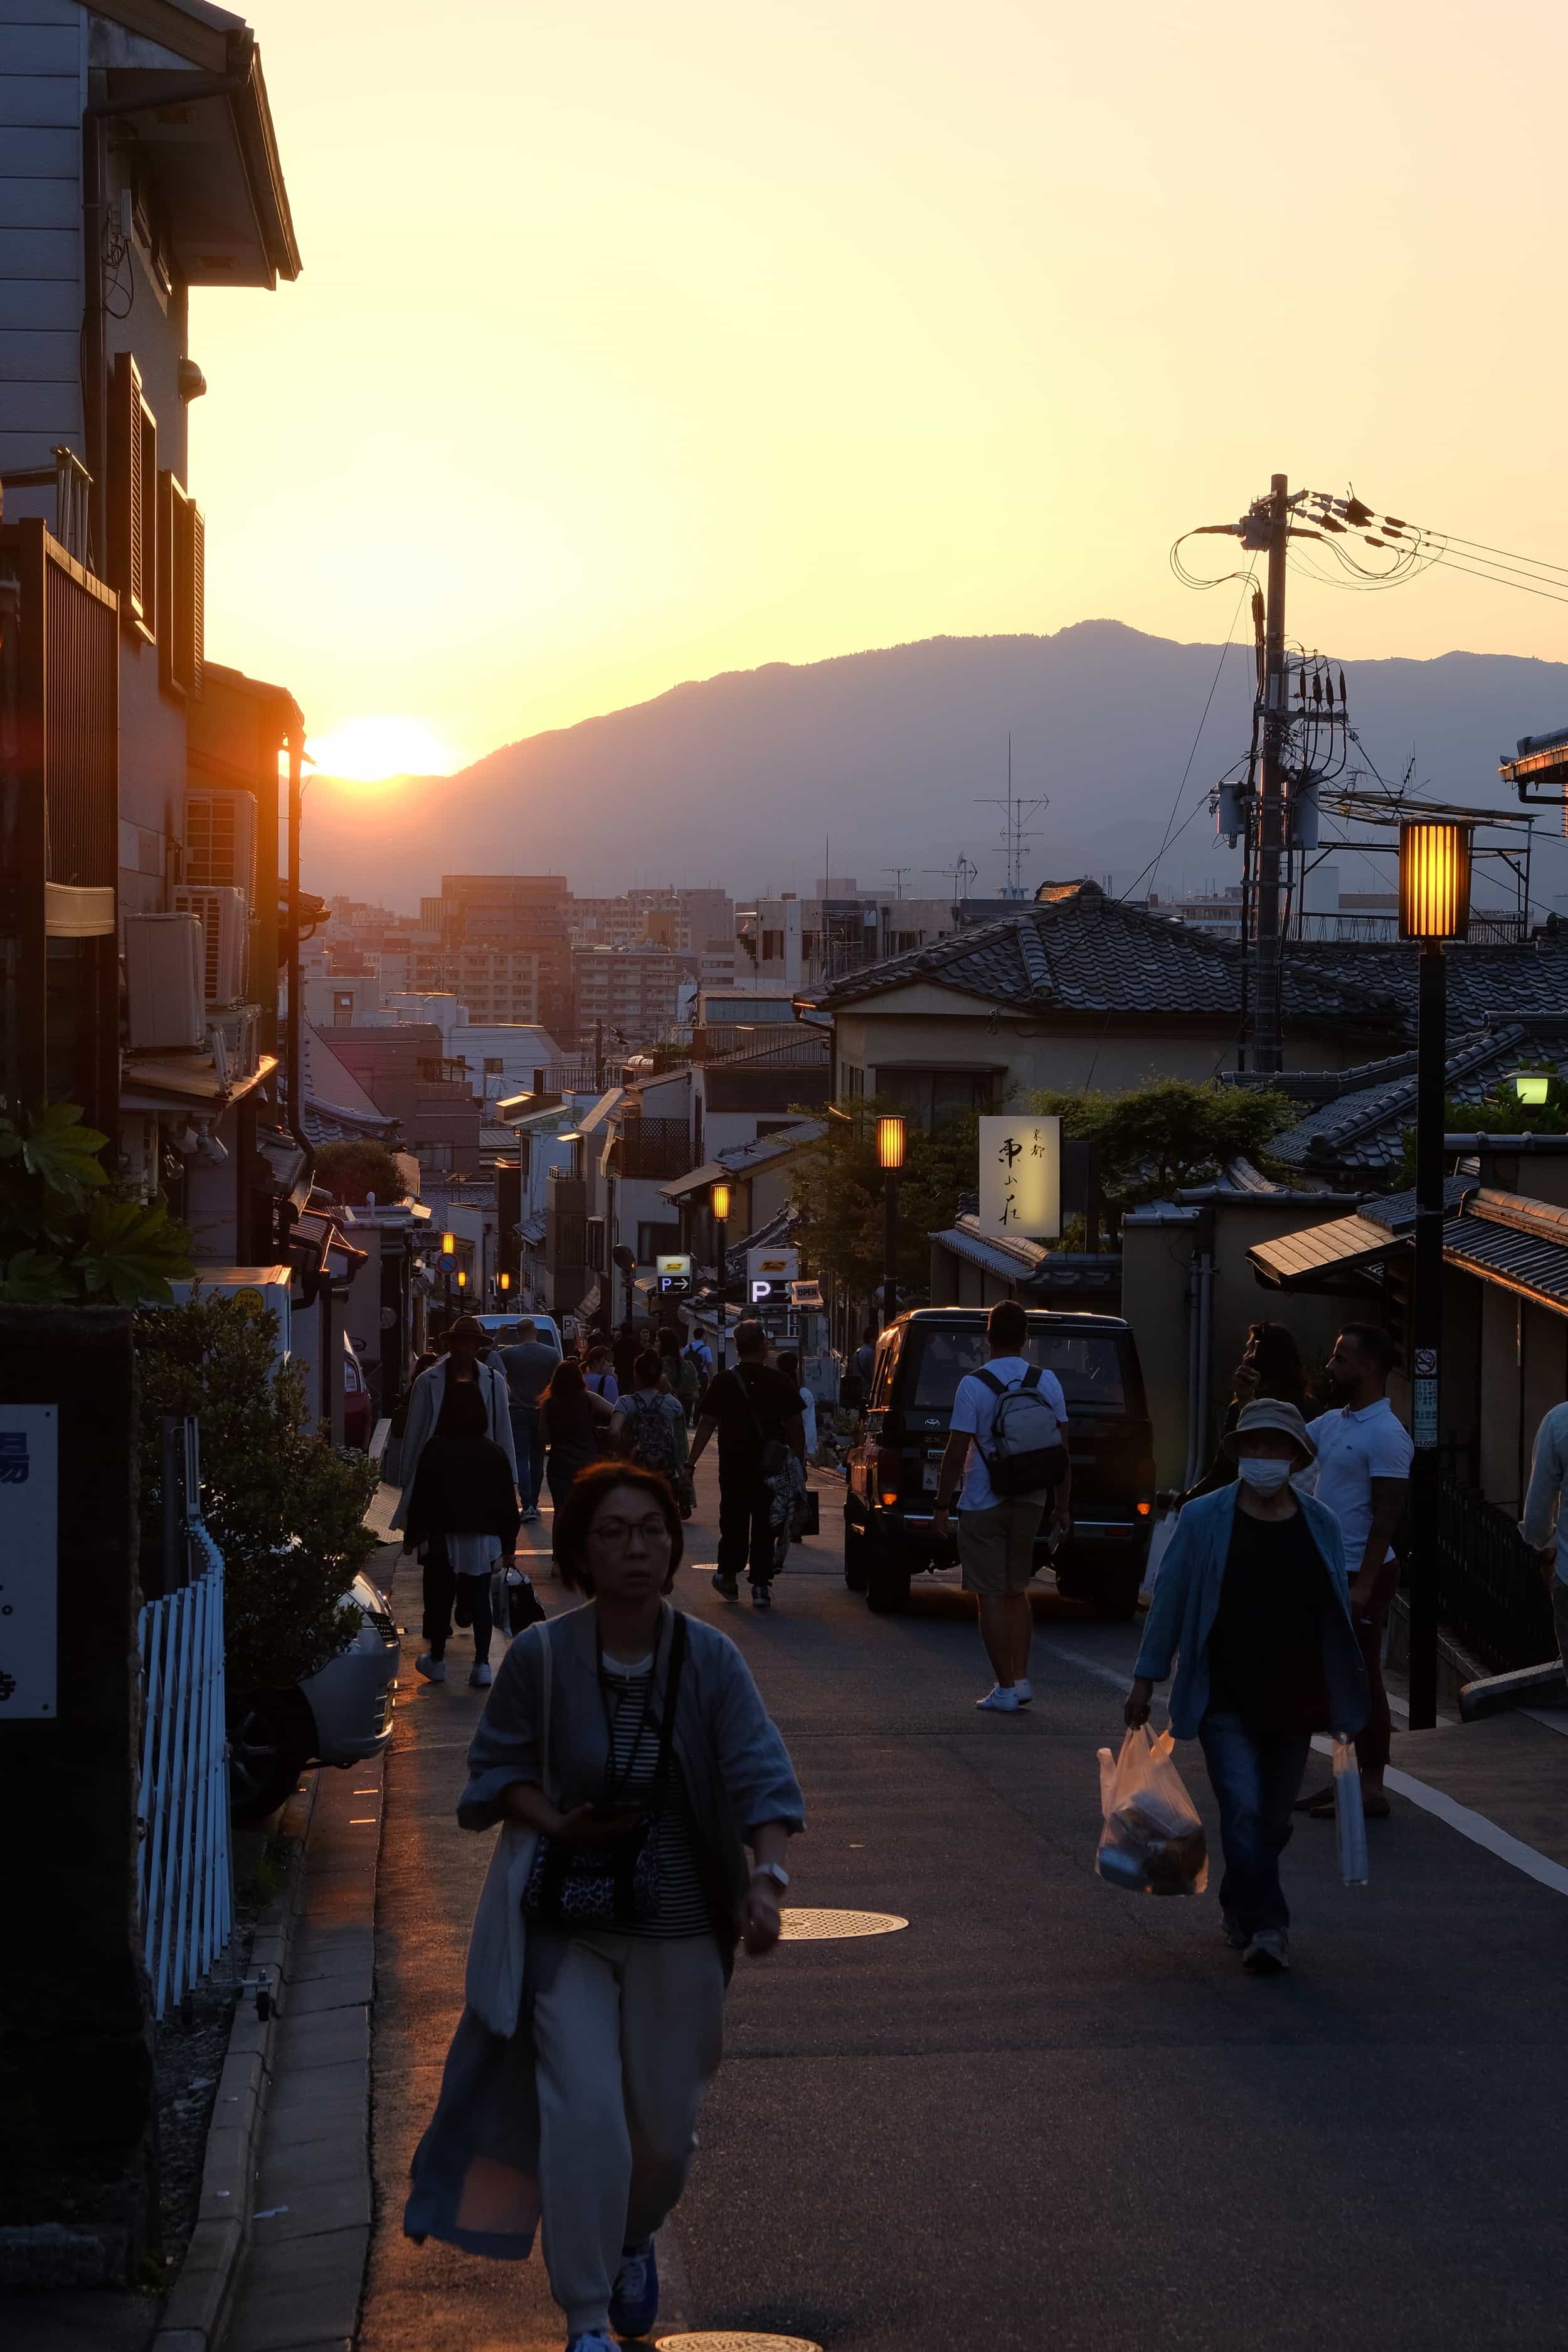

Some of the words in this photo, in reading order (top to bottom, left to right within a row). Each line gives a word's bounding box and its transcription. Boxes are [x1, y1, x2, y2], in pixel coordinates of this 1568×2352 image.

[1030, 1129, 1045, 1158] 京都
[662, 1278, 672, 1291] P
[753, 1281, 771, 1303] P
[797, 1288, 817, 1296] OPEN
[564, 1320, 572, 1330] P
